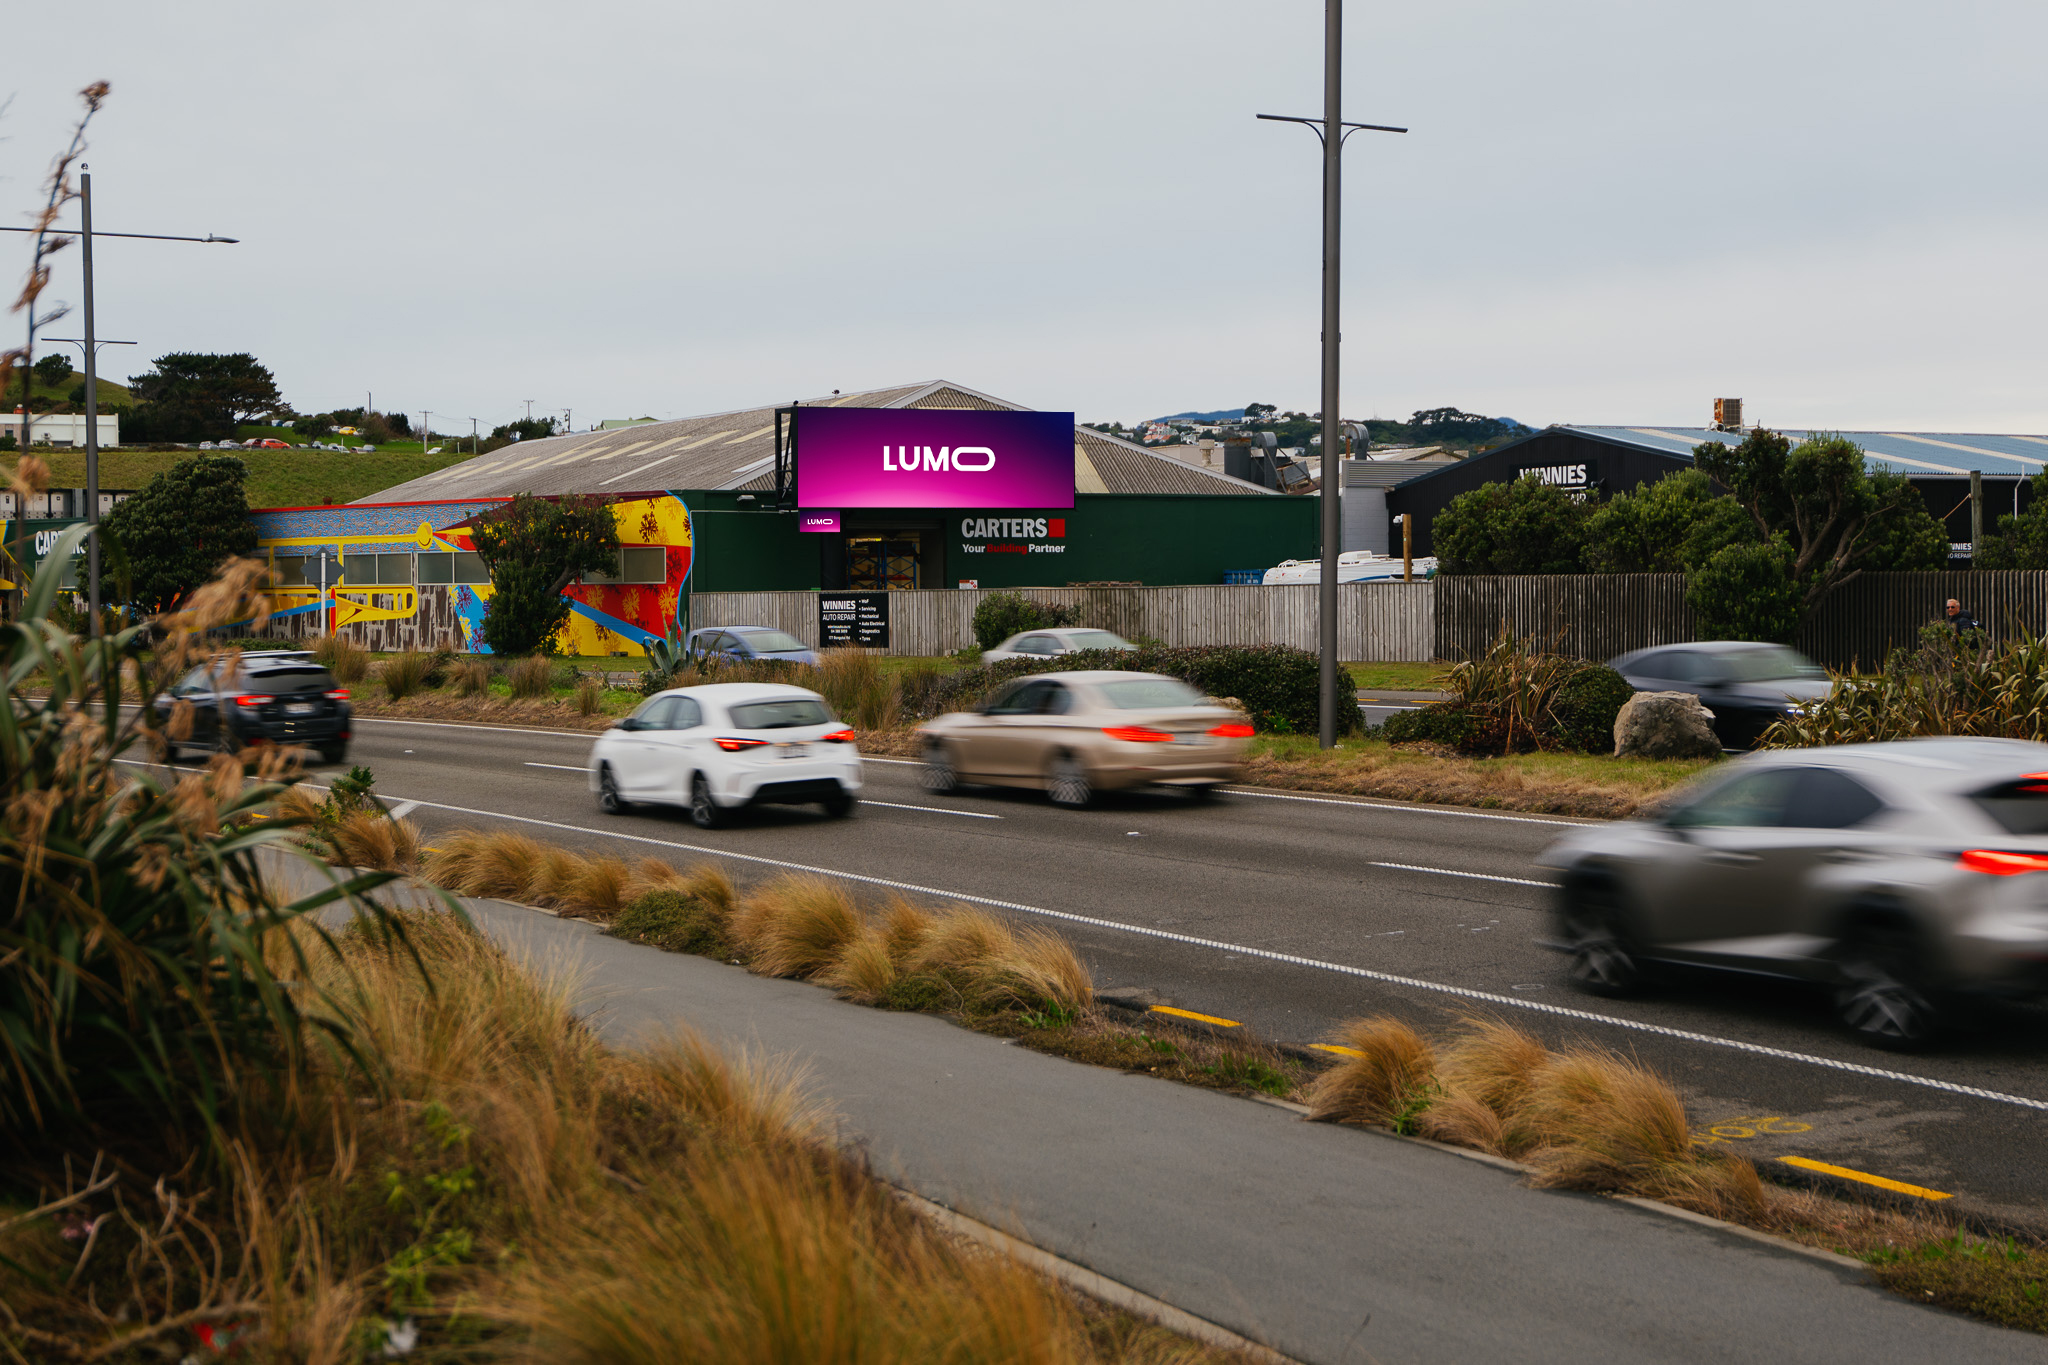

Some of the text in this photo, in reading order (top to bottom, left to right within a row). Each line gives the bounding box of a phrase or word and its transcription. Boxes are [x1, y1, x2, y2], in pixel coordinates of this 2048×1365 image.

[883, 445, 996, 472] LUMO
[961, 518, 1048, 538] CARTERS
[962, 543, 1065, 555] Your Building Partner
[822, 600, 856, 610] WINNIES
